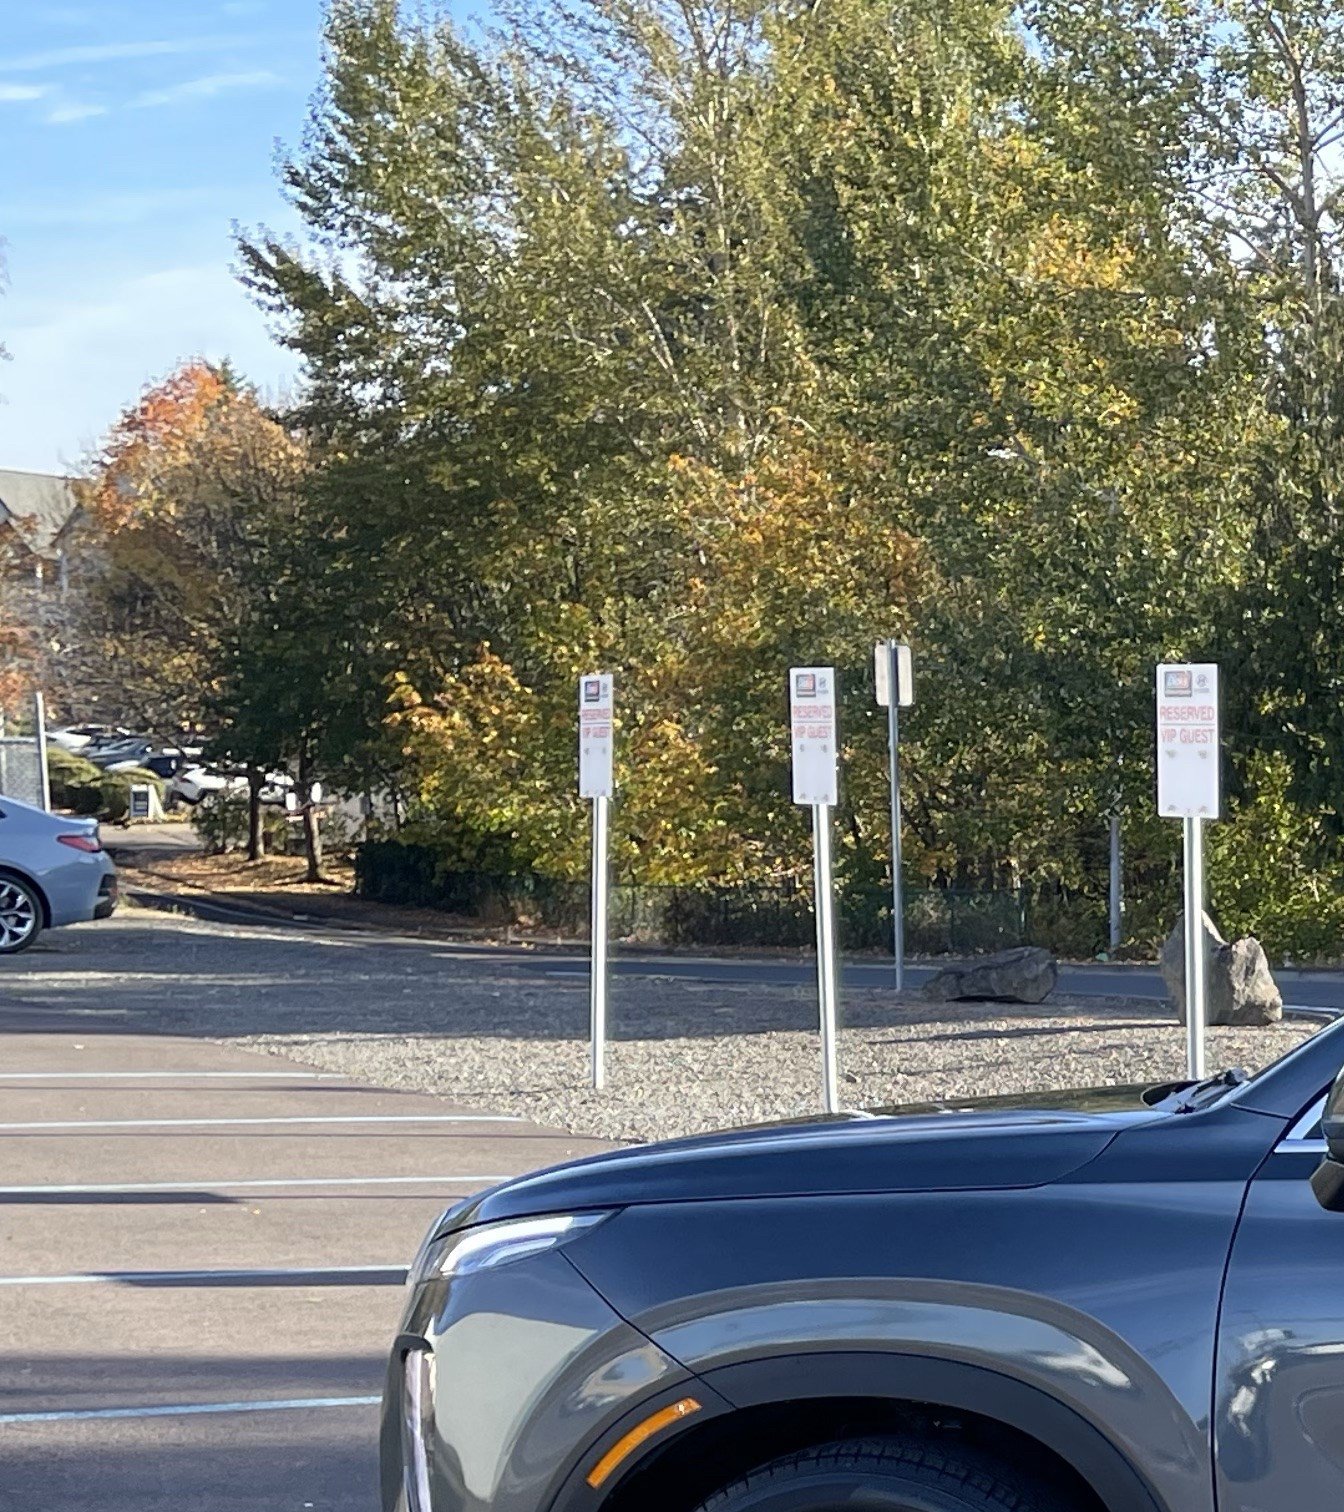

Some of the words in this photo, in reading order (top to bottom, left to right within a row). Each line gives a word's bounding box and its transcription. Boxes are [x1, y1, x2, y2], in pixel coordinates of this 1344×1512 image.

[1159, 706, 1215, 720] RESERVED
[1161, 728, 1177, 742] VIP
[1179, 728, 1215, 743] GUEST
